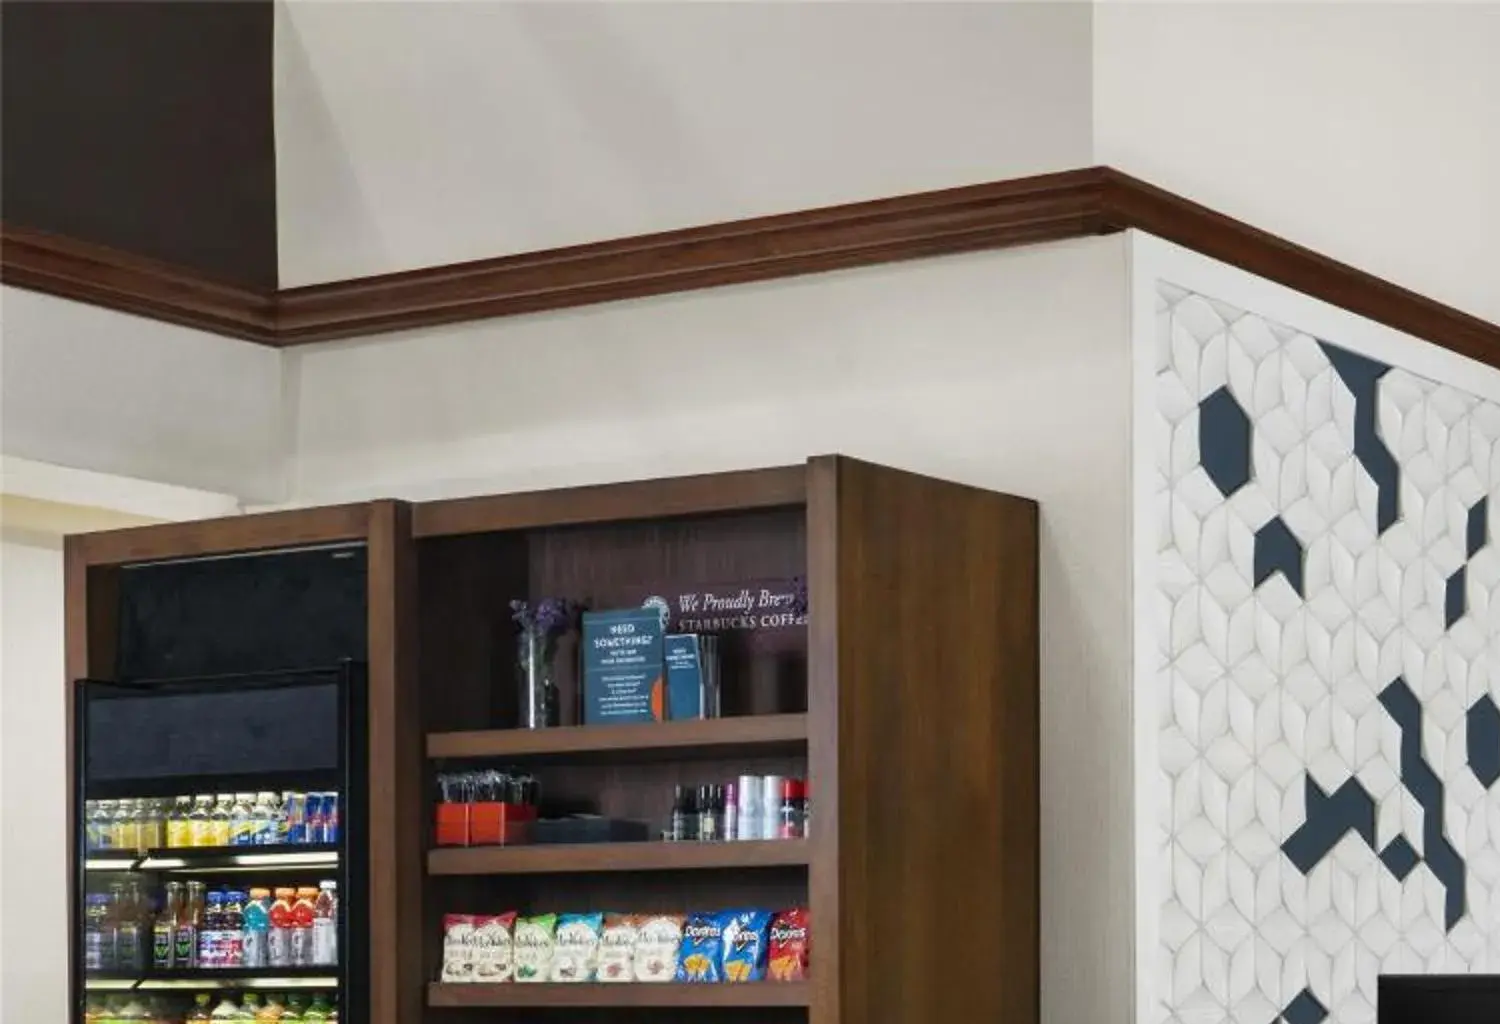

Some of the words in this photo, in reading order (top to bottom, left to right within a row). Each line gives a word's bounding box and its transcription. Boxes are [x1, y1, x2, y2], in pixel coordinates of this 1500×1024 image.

[679, 593, 698, 612] We
[703, 589, 755, 615] Proudly
[679, 615, 757, 632] STARBUCKS
